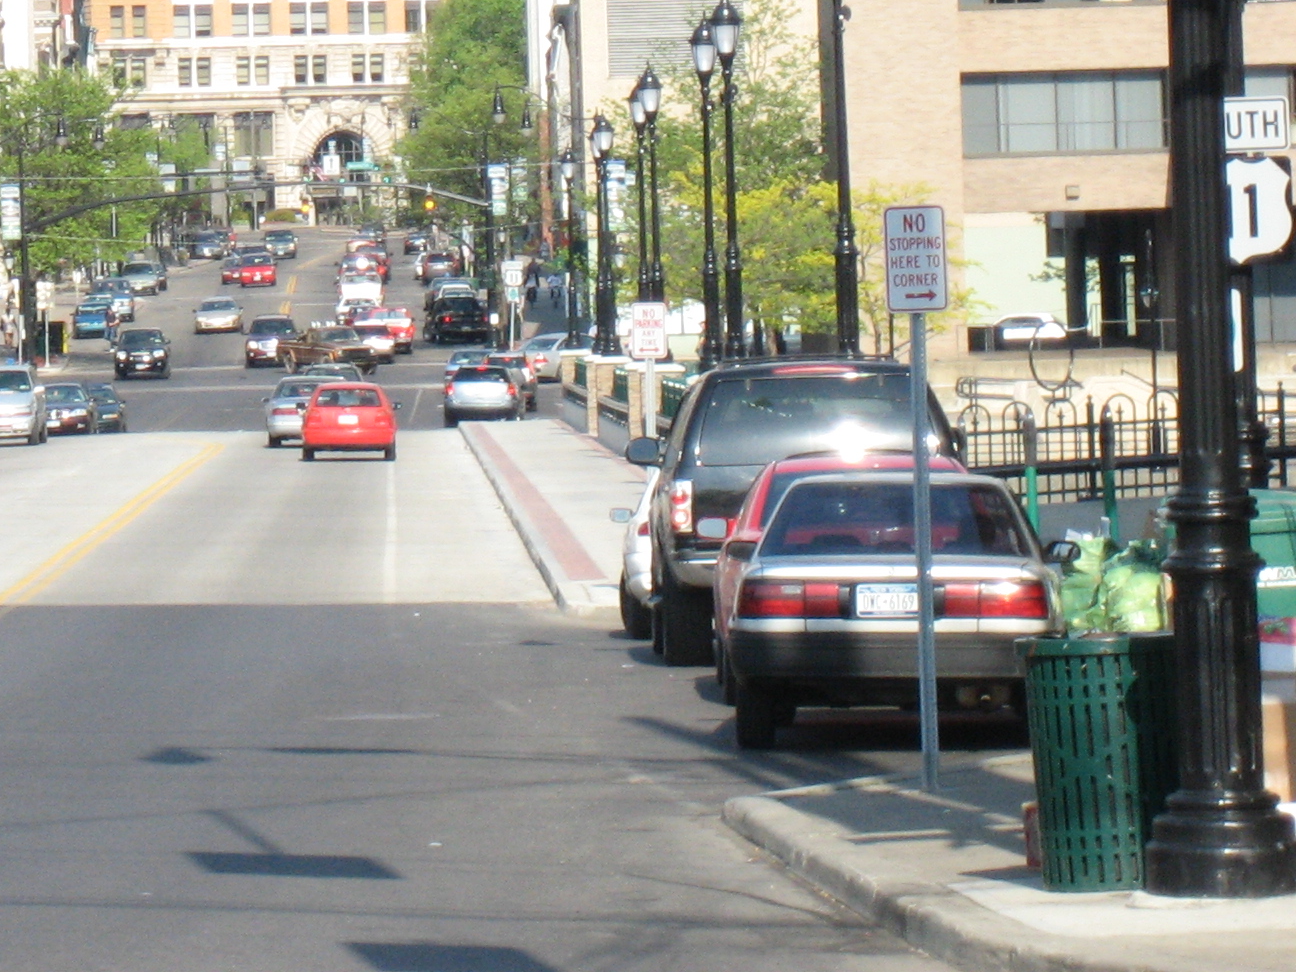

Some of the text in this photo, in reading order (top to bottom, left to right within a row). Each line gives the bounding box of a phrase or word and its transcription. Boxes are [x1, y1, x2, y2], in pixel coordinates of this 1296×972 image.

[1226, 110, 1279, 139] UTH
[903, 214, 925, 233] NO
[889, 237, 941, 251] STOPPING
[891, 255, 940, 268] HERE TO
[894, 273, 938, 286] CORNER
[642, 309, 655, 318] NO
